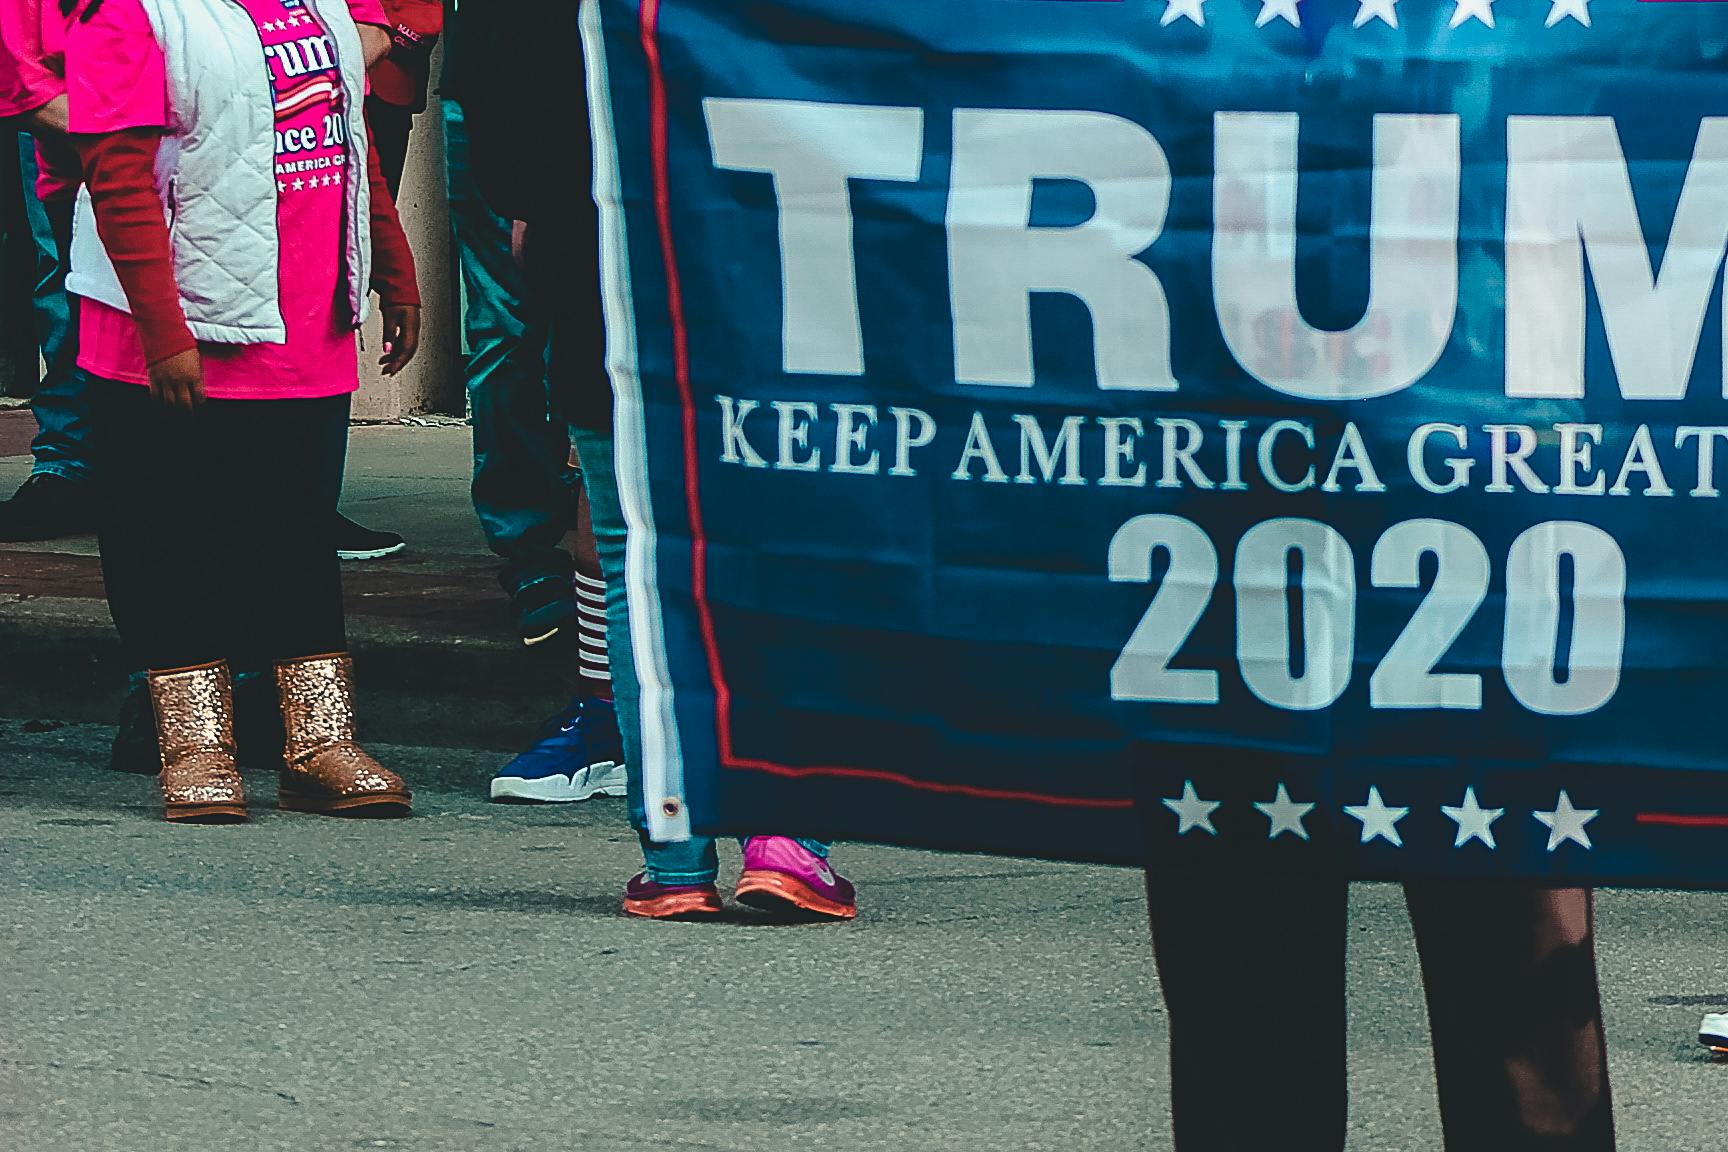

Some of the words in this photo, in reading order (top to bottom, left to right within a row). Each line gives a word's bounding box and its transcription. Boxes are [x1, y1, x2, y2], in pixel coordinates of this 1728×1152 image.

[276, 155, 331, 175] AMERICA
[718, 394, 938, 477] KEEP
[950, 410, 1388, 493] AMERICA
[1107, 513, 1627, 716] 2020
